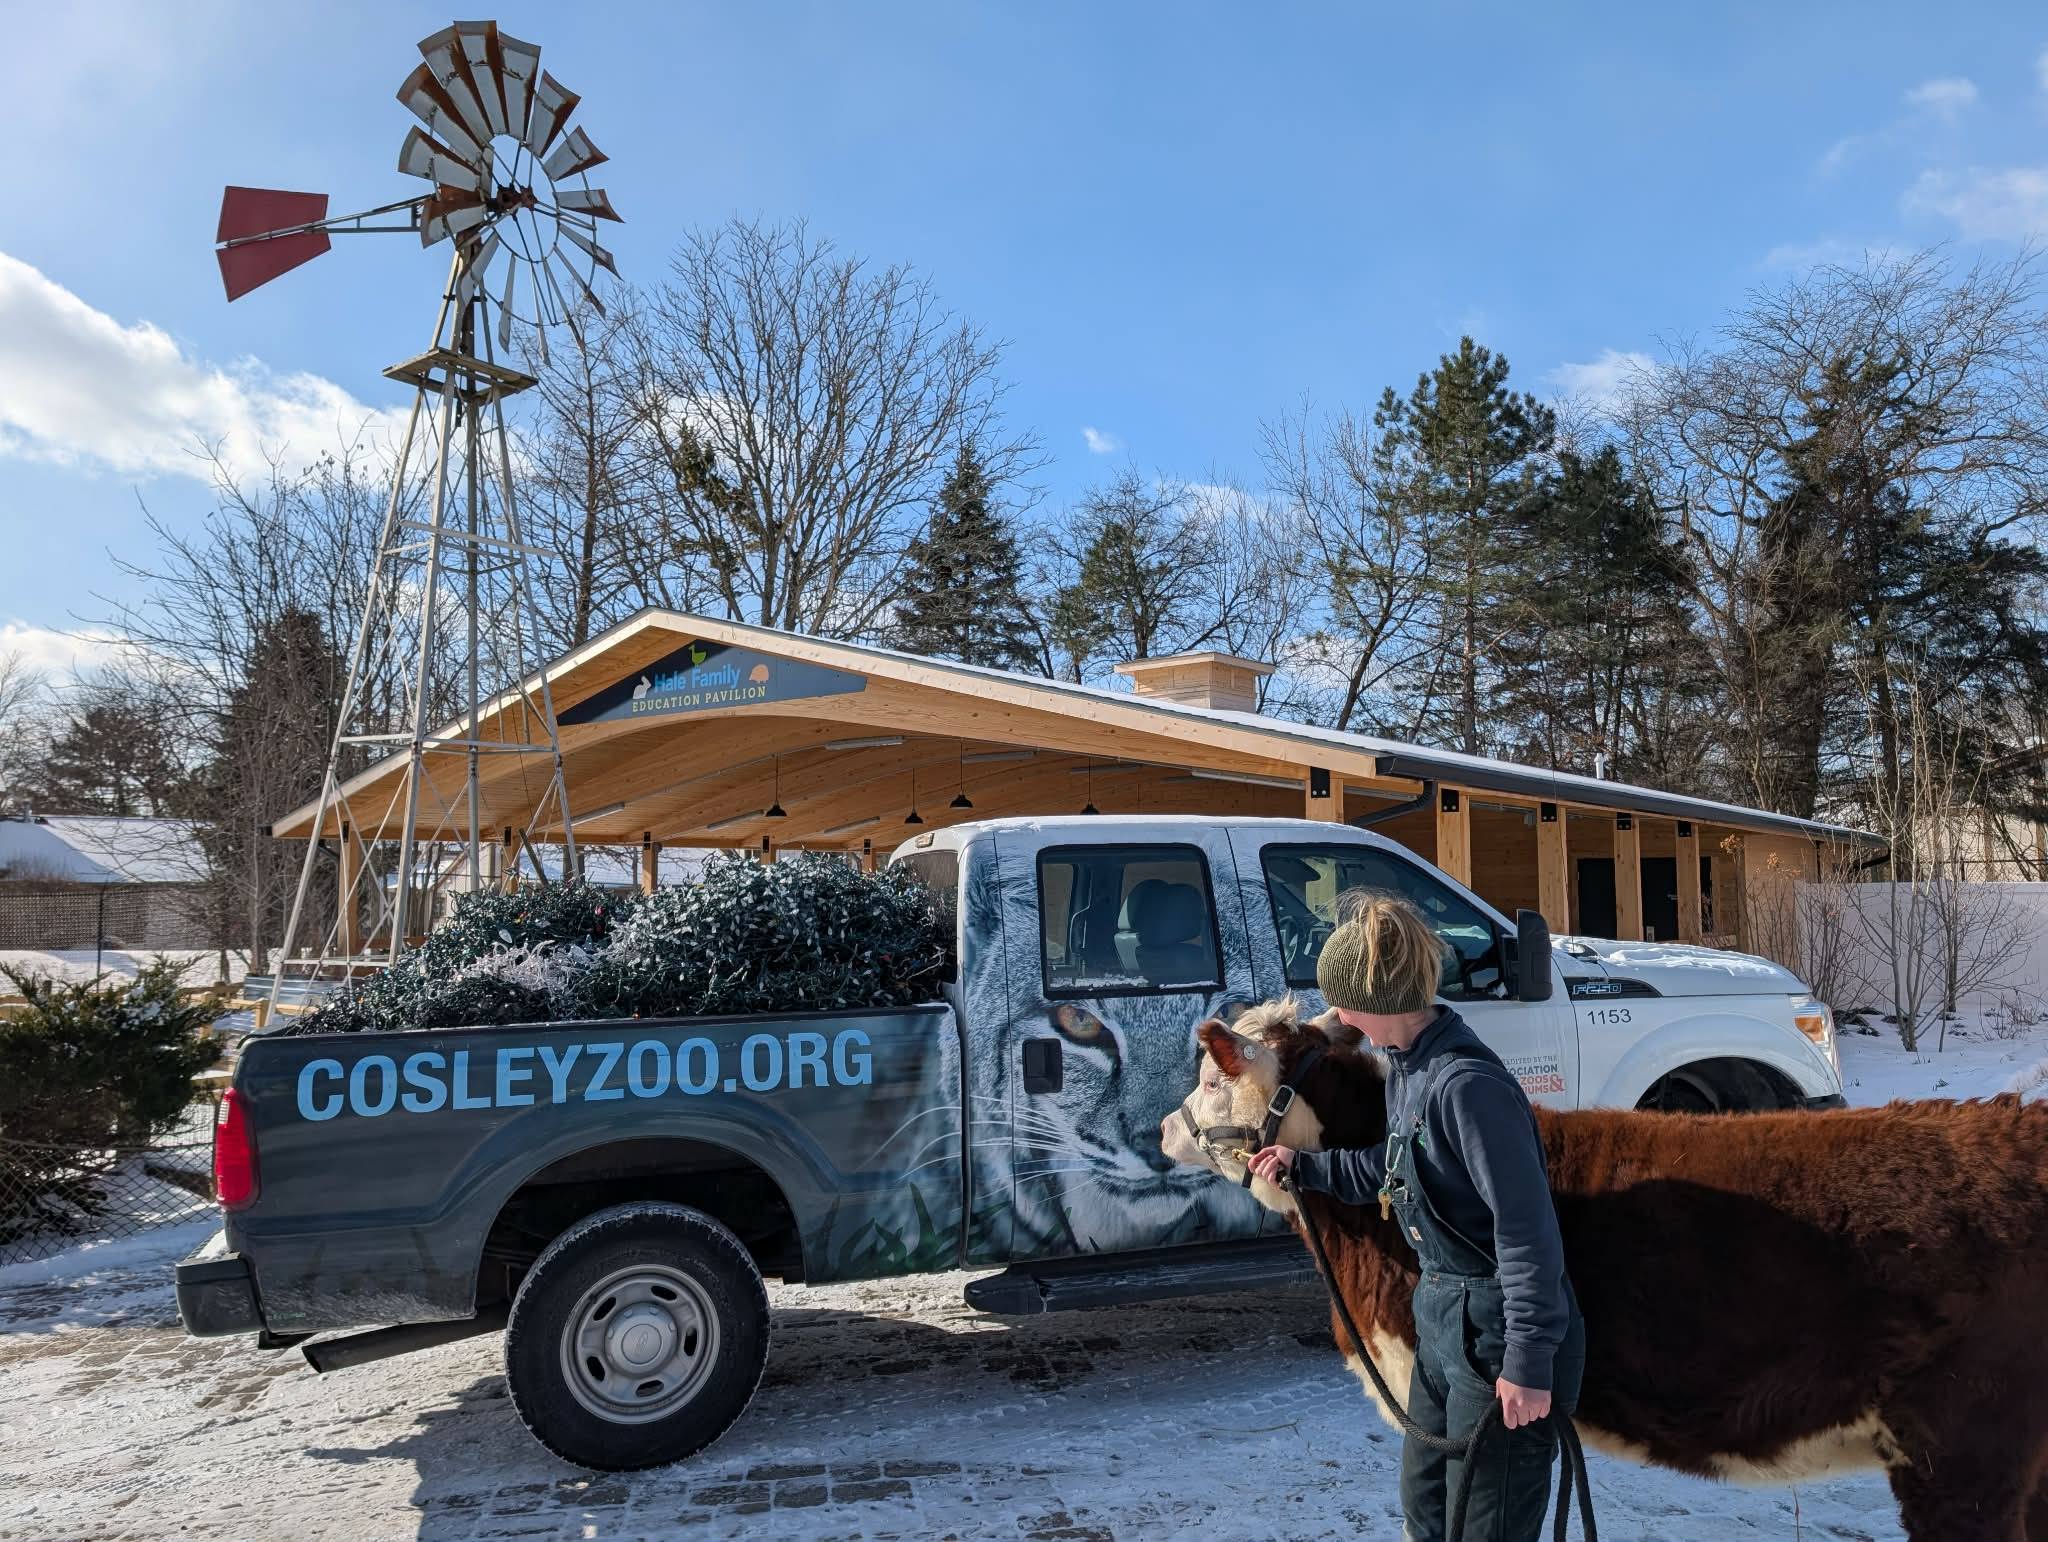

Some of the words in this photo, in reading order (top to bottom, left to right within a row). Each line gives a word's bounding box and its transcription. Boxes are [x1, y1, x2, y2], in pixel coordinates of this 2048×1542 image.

[654, 671, 687, 693] Hale
[691, 663, 741, 689] Family
[632, 694, 700, 713] EDUCATION
[705, 686, 766, 704] PAVILION
[1587, 1008, 1632, 1025] 1153
[297, 1029, 873, 1121] COSLEYZOO.ORG
[1508, 1063, 1558, 1076] OCIATION
[1520, 1074, 1549, 1086] ZOOS
